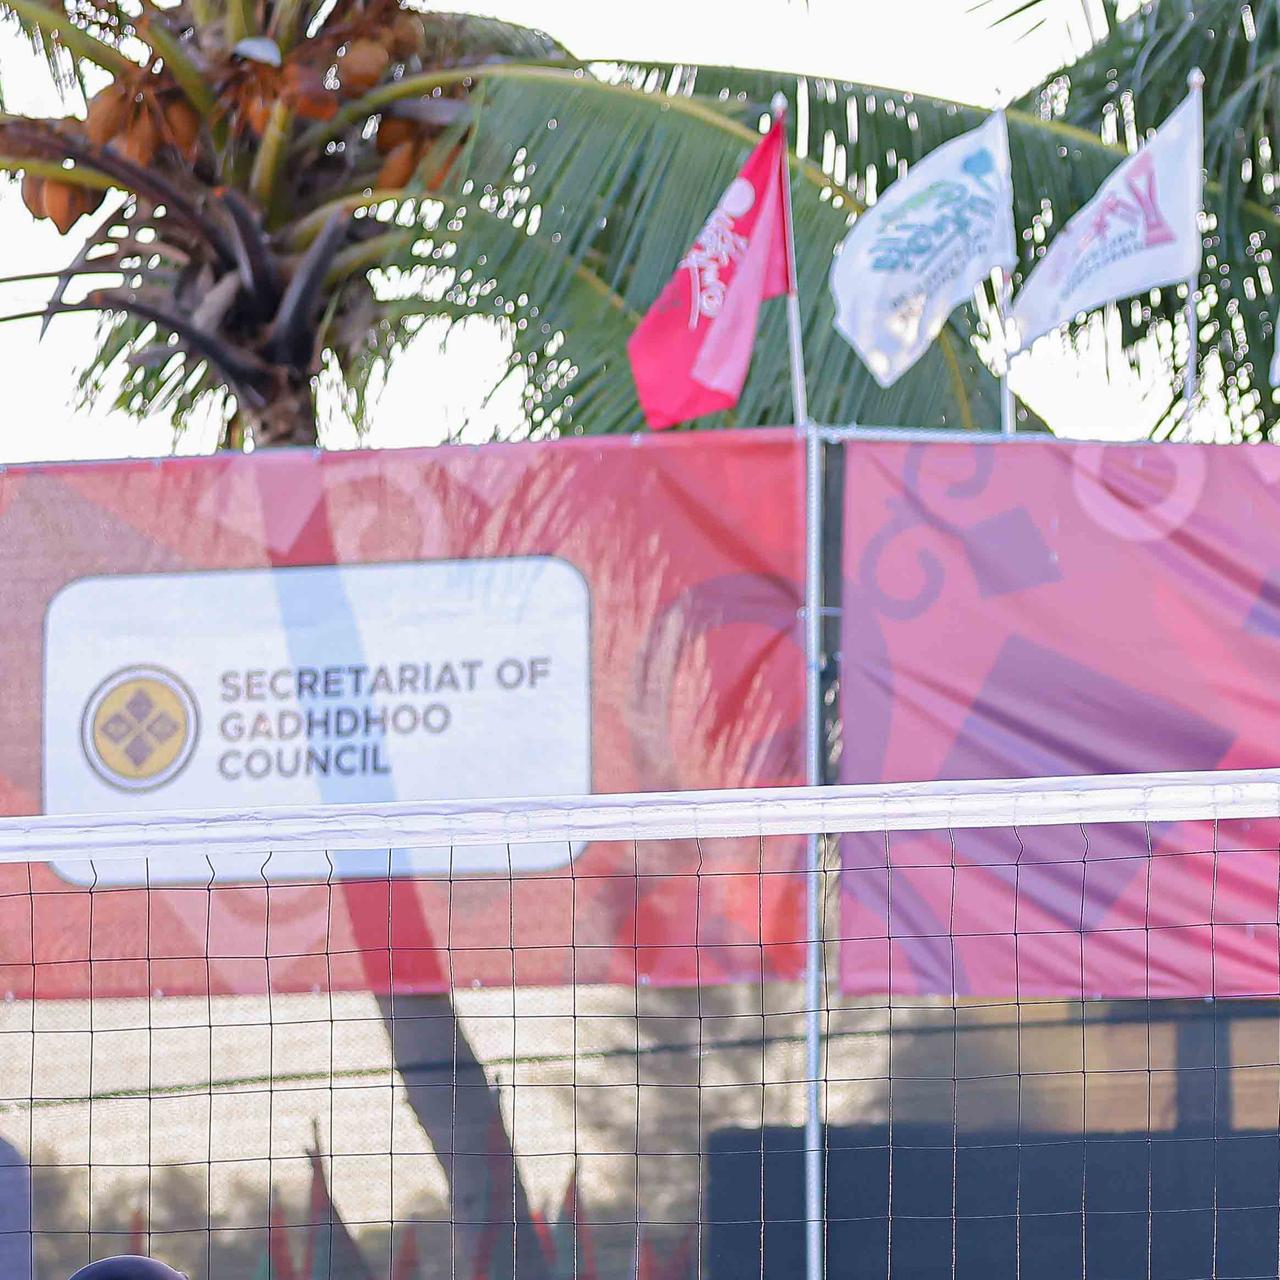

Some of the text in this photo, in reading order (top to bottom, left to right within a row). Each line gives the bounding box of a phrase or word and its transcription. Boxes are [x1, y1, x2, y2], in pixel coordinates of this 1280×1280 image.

[220, 657, 552, 703] SECRETARIAT OF
[219, 702, 452, 743] GADHDHOO
[218, 742, 391, 781] COUNCIL
